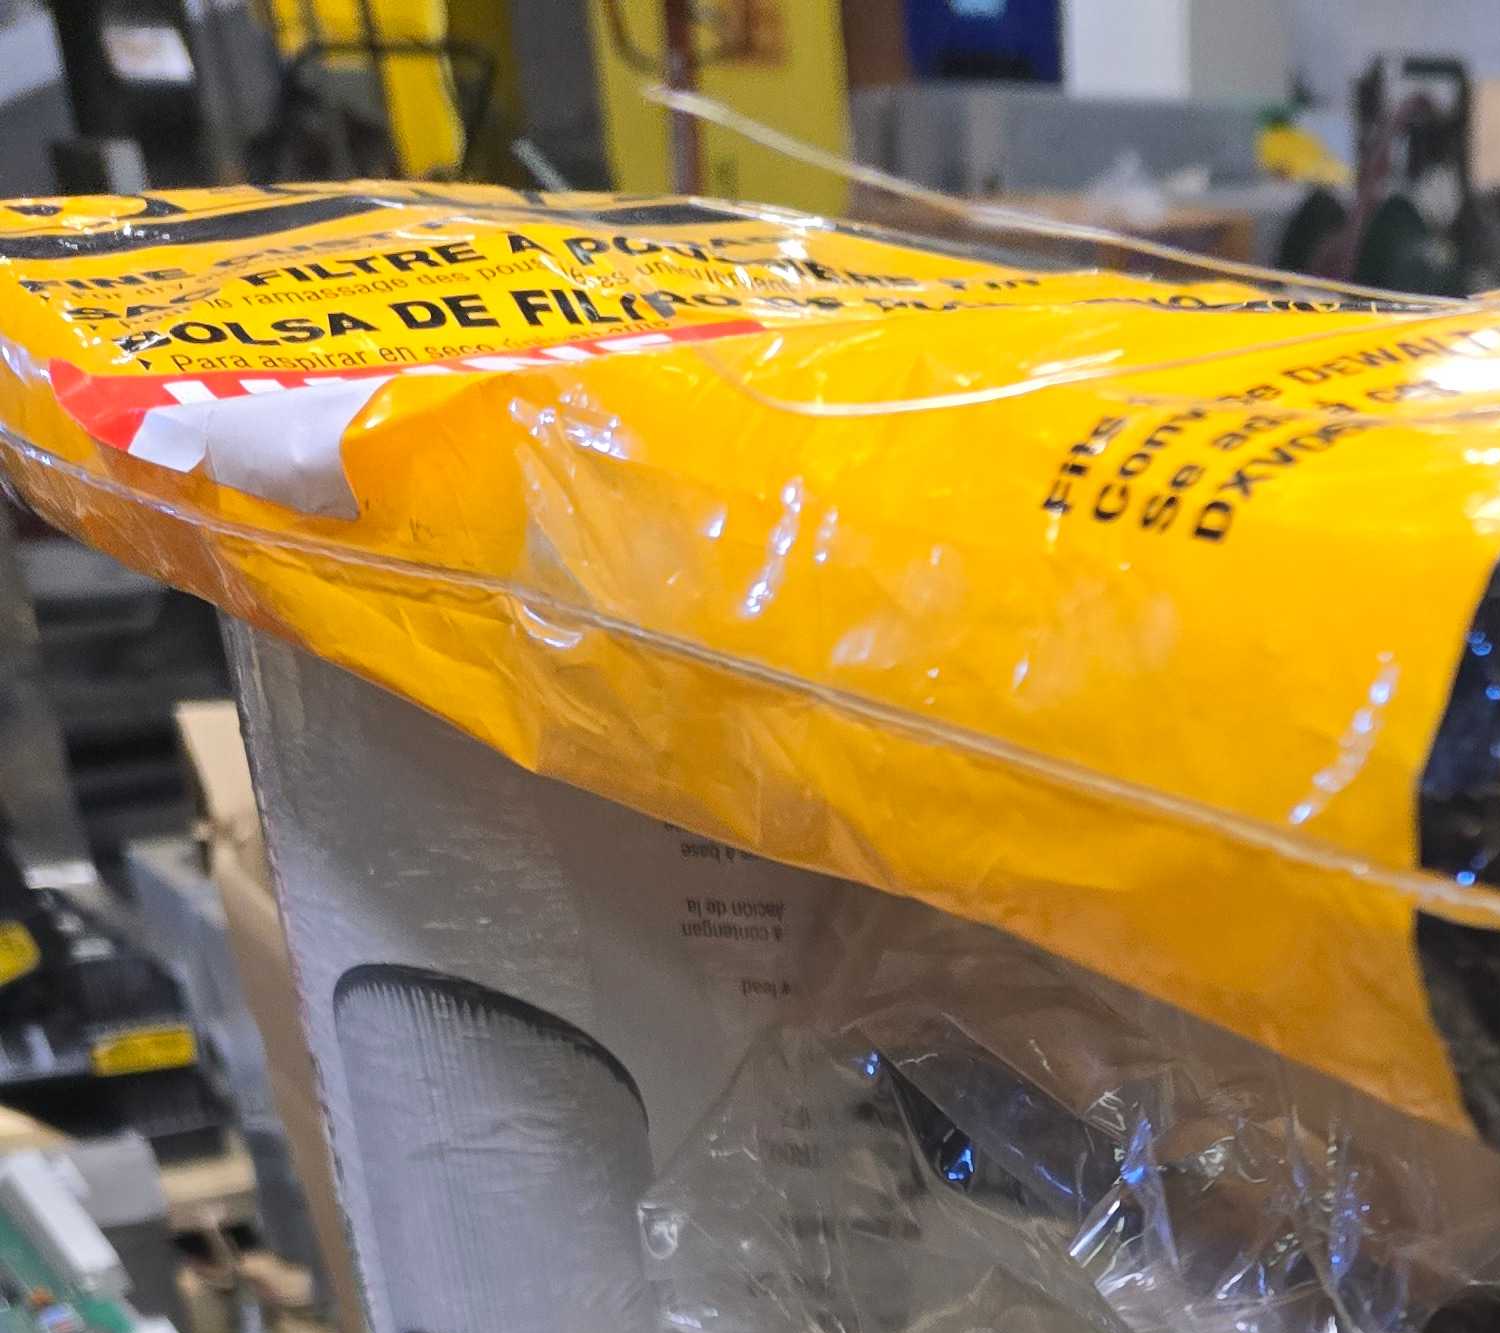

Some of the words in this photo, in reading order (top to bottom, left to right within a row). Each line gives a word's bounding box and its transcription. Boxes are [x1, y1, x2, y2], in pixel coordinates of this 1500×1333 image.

[240, 240, 489, 288] FILTRE
[416, 267, 471, 288] des
[112, 310, 379, 352] BOLSA
[387, 292, 503, 331] DE
[170, 352, 259, 374] Para
[261, 346, 368, 375] aspirar
[378, 343, 418, 364] en
[1139, 463, 1207, 533] Se
